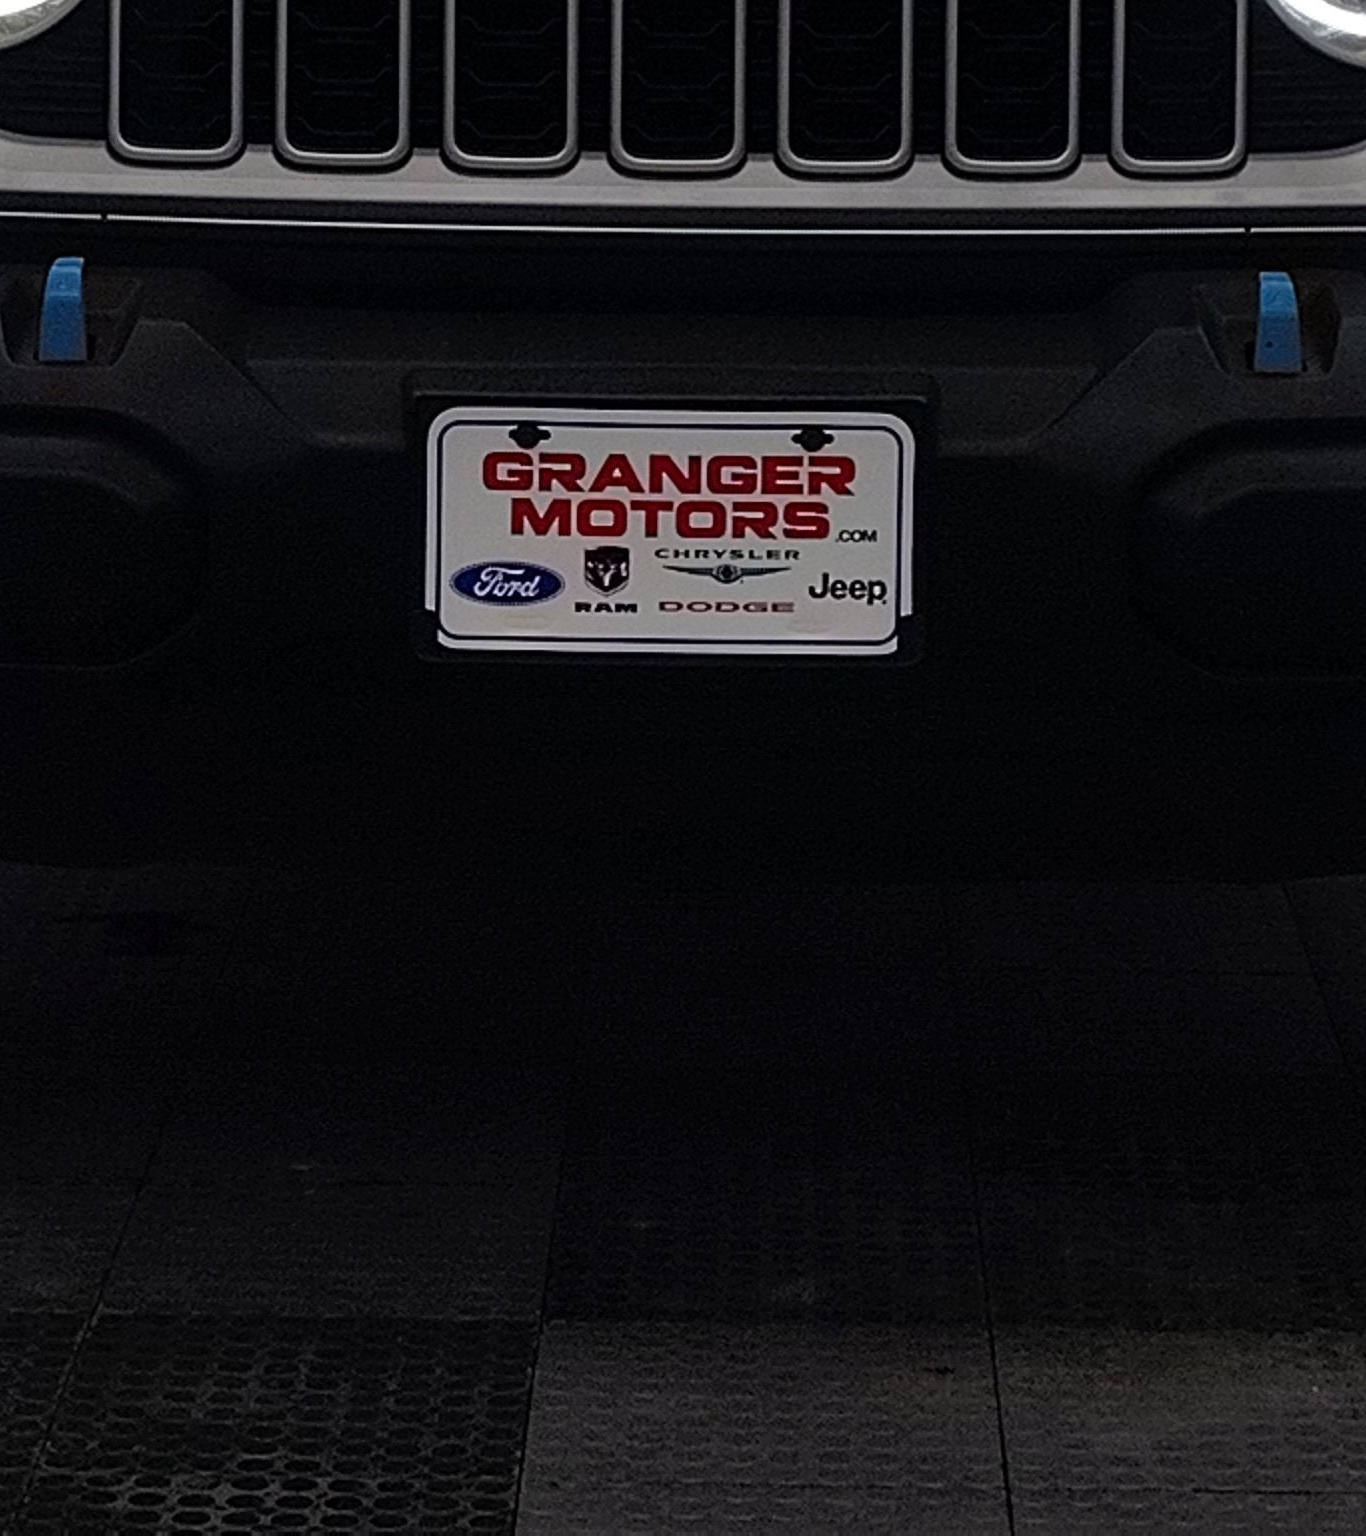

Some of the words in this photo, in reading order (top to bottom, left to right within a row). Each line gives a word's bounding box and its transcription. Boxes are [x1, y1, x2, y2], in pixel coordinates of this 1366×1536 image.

[482, 452, 856, 496] GRANGER
[510, 498, 831, 540] MOTORS
[835, 529, 878, 543] .COM
[654, 548, 801, 561] CHRYSLER
[473, 566, 541, 597] Ford
[808, 572, 887, 605] Jeep
[574, 602, 639, 613] RAM
[658, 601, 795, 613] DODGE
